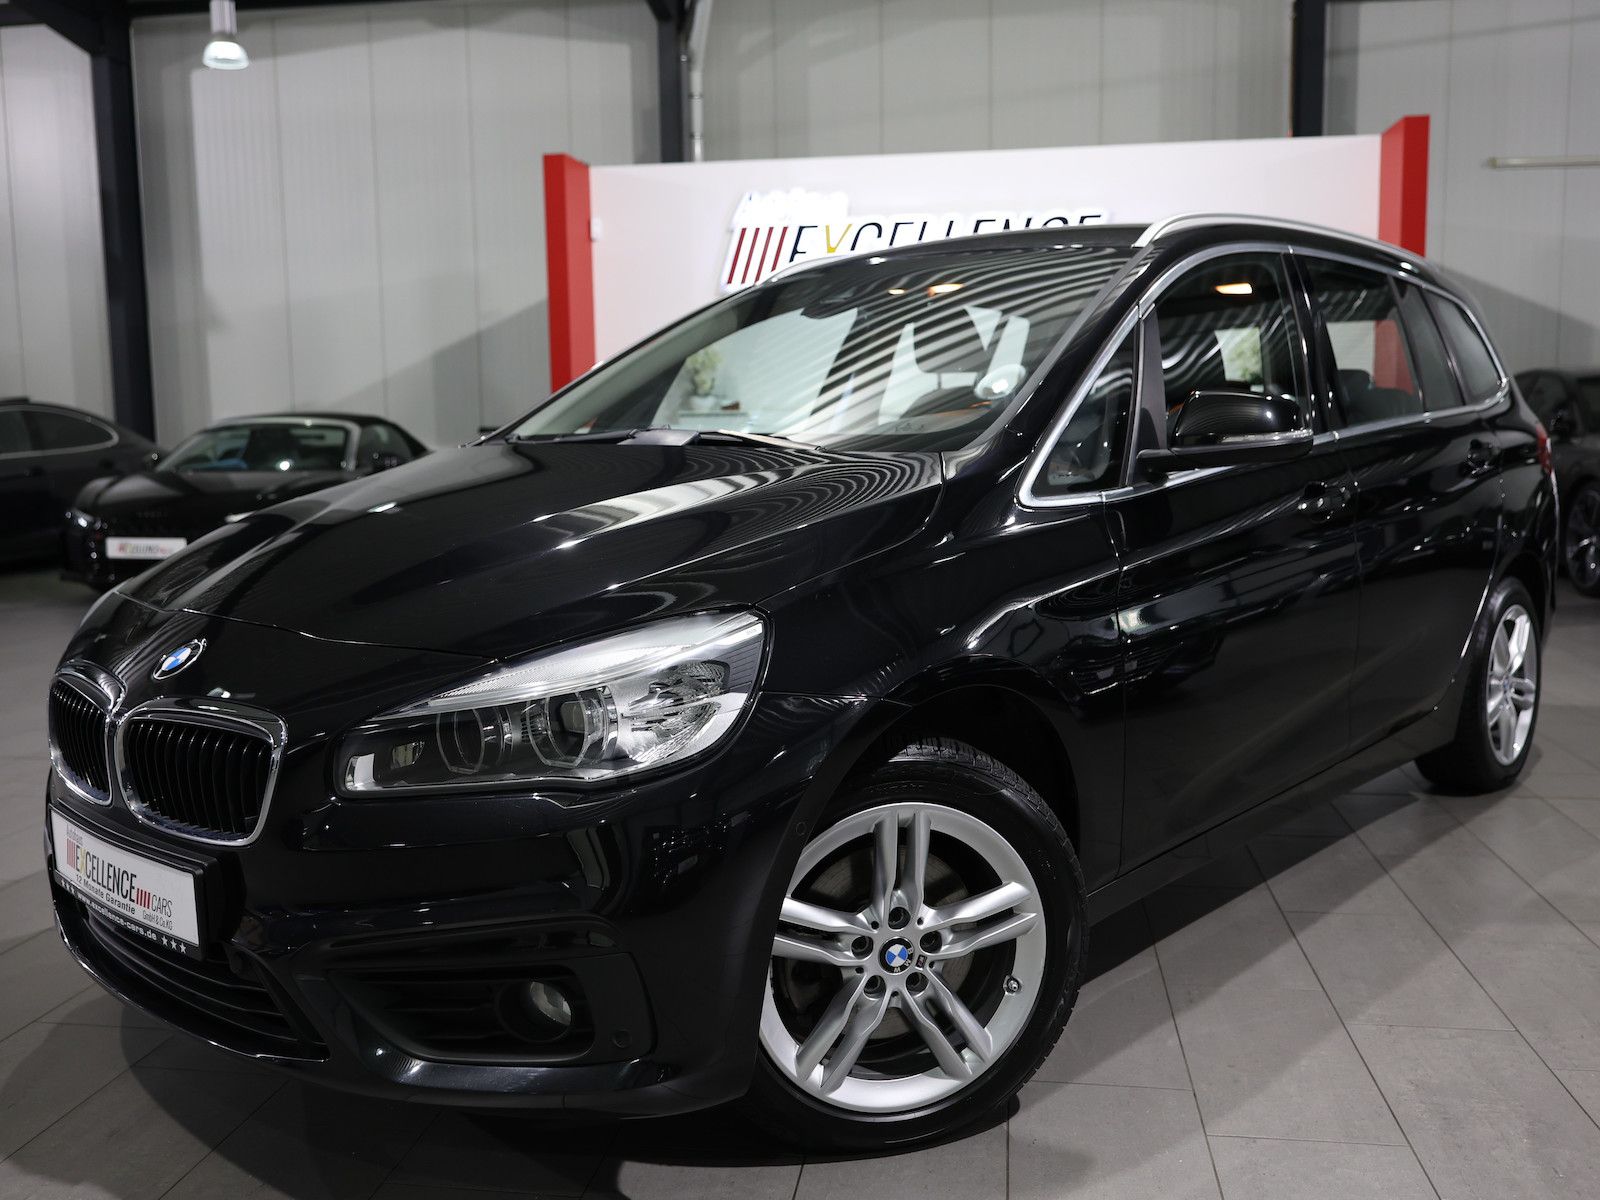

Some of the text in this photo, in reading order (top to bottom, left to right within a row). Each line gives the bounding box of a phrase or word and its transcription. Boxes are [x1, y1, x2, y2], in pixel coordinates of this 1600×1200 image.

[75, 845, 173, 918] EXCELLENCE CARS
[83, 879, 104, 898] Monate
[105, 893, 136, 915] Garantie
[77, 891, 158, 941] www.excellence-cars.de
